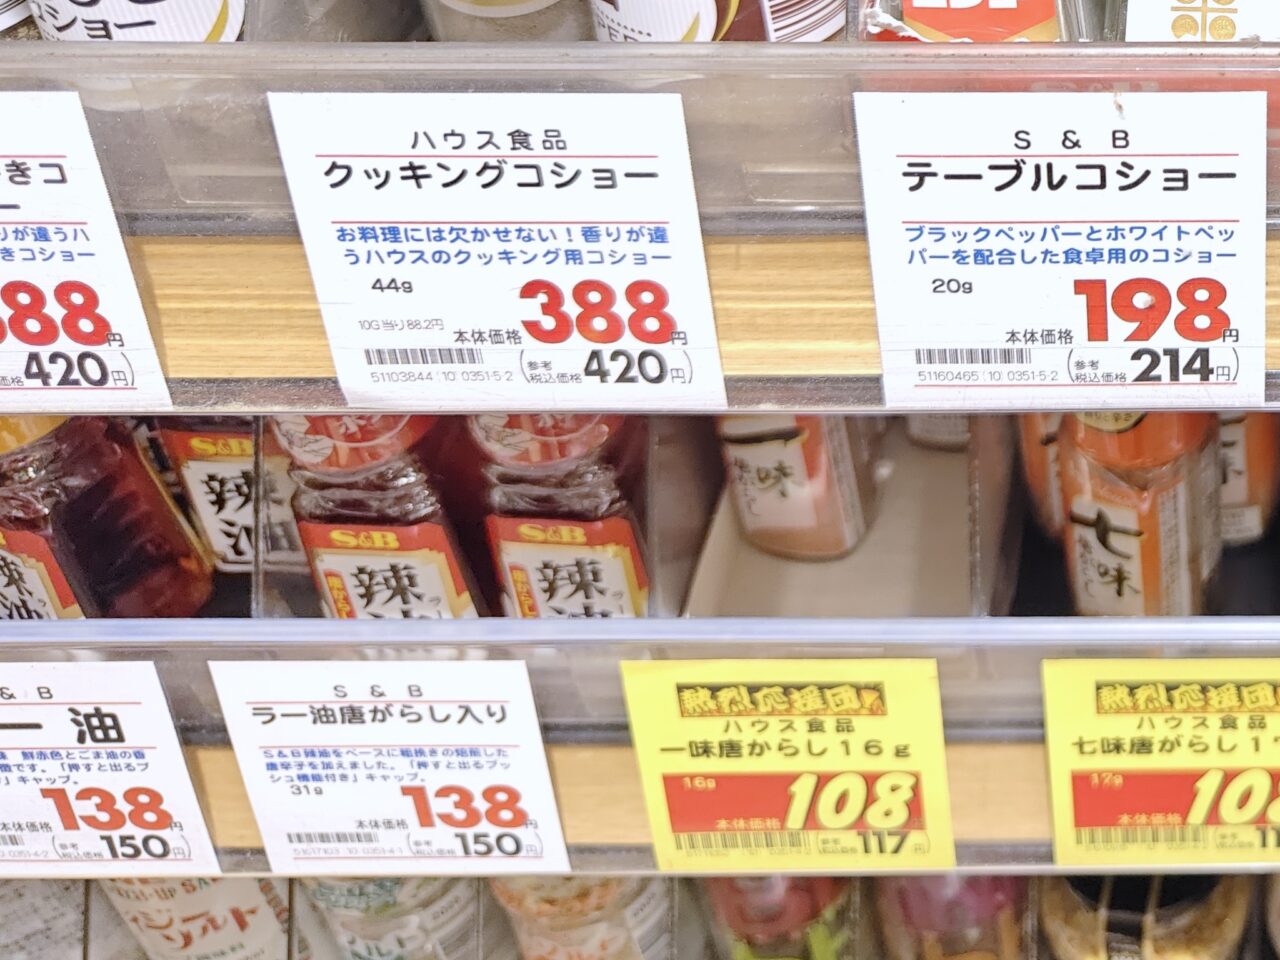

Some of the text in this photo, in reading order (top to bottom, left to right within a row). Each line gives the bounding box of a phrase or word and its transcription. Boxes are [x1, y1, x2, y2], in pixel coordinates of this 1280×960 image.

[410, 129, 568, 150] ハウス食品
[323, 160, 659, 190] クッキングコショー
[902, 159, 1236, 192] テーブルコショー
[336, 226, 670, 244] お料理には欠かせない!香りが違
[905, 225, 1235, 242] ブラックペッパーとホワイトペッ
[344, 249, 673, 266] うハウスのクッキング用コショー
[907, 248, 1237, 265] パーを配合した食卓用のコショー
[371, 278, 413, 293] 44g
[931, 279, 974, 294] 20g
[453, 329, 523, 345] 本体価格
[1005, 329, 1074, 345] 本体価格
[329, 529, 400, 549] S&B
[518, 523, 587, 544] S&B
[252, 704, 508, 725] ラー油唐がらし入り
[1136, 715, 1267, 730] ハウス食品
[723, 718, 856, 734] ハウス食品
[784, 771, 918, 830] 108
